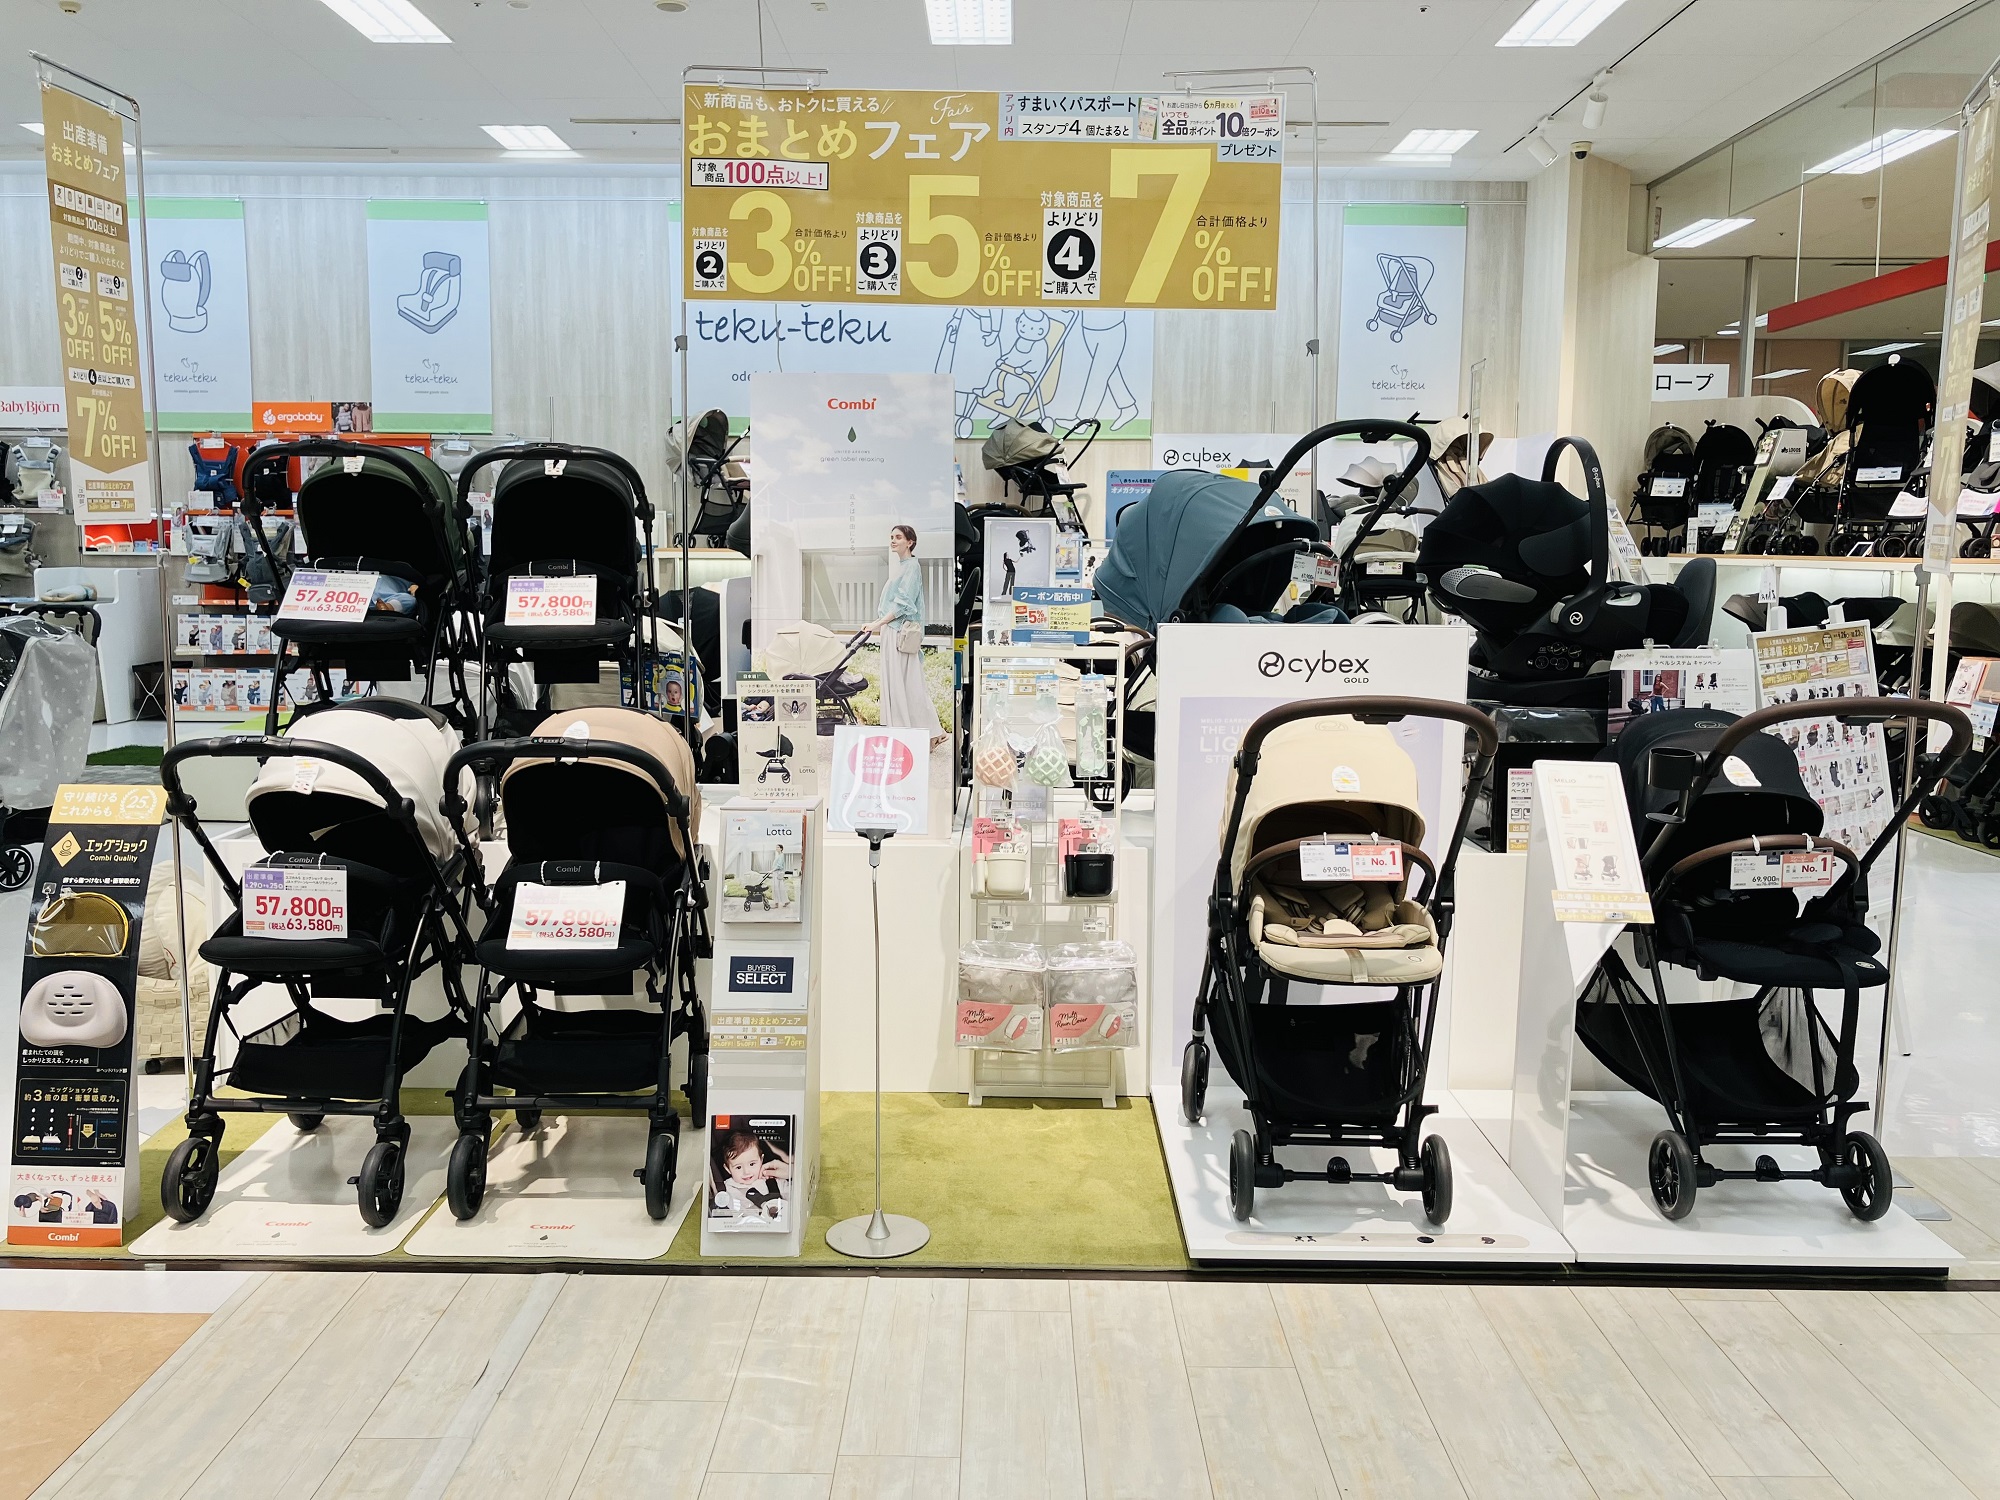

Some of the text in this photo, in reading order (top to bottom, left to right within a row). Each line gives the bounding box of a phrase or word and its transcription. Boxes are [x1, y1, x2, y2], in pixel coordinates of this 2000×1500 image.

[704, 92, 880, 113] 新商品も、おトクに買える
[1017, 95, 1137, 113] すまいくパスポート
[930, 94, 974, 125] Fair
[1004, 94, 1014, 136] アプリ内
[62, 120, 108, 155] 出産準備
[688, 114, 991, 162] おまとめフェア
[1221, 144, 1277, 157] プレゼント
[51, 143, 120, 182] おまとめフェア
[697, 162, 717, 172] 対象
[704, 172, 725, 182] 商品
[1041, 191, 1104, 208] 対象商品を
[855, 212, 903, 224] 対象商品を
[1047, 211, 1098, 227] よりどり
[1196, 215, 1268, 228] 合計価格より
[692, 227, 728, 238] 対象商品を
[794, 228, 848, 238] 合計価格より
[859, 229, 899, 241] よりどり
[984, 232, 1037, 242] 合計価格より
[695, 240, 725, 250] よりどり
[694, 280, 725, 288] ご購入で
[793, 266, 851, 293] OFF!
[983, 270, 1041, 297] OFF!
[1192, 265, 1272, 302] OFF!
[857, 282, 898, 292] ご購入で
[1043, 281, 1096, 294] ご購入で
[695, 308, 892, 345] teku-teku
[67, 338, 95, 361] OFF!
[103, 345, 133, 366] OFF!
[163, 372, 218, 384] teku-teku
[405, 374, 458, 385] teku-teku
[1371, 379, 1426, 391] teku-teku
[827, 398, 877, 410] Combi
[277, 412, 323, 423] ergobaby
[101, 435, 136, 459] OFF!
[859, 456, 884, 464] relaxing
[1183, 447, 1231, 467] cybex
[295, 590, 367, 605] 57,800円
[518, 595, 592, 608] 57,800円
[1020, 592, 1083, 602] クーポン配布中!
[1288, 650, 1369, 682] cybex
[1201, 726, 1226, 734] THE
[1200, 736, 1238, 752] LIG
[59, 806, 113, 816] これからも
[766, 827, 792, 836] Lotta
[84, 839, 148, 852] エッグショック
[113, 854, 138, 862] Quality
[1371, 858, 1387, 866] No.
[1820, 857, 1828, 871] 1
[256, 896, 343, 918] 57,800円
[525, 909, 617, 926] 57,800円
[736, 973, 787, 985] SELECT
[48, 1232, 80, 1242] Combi
